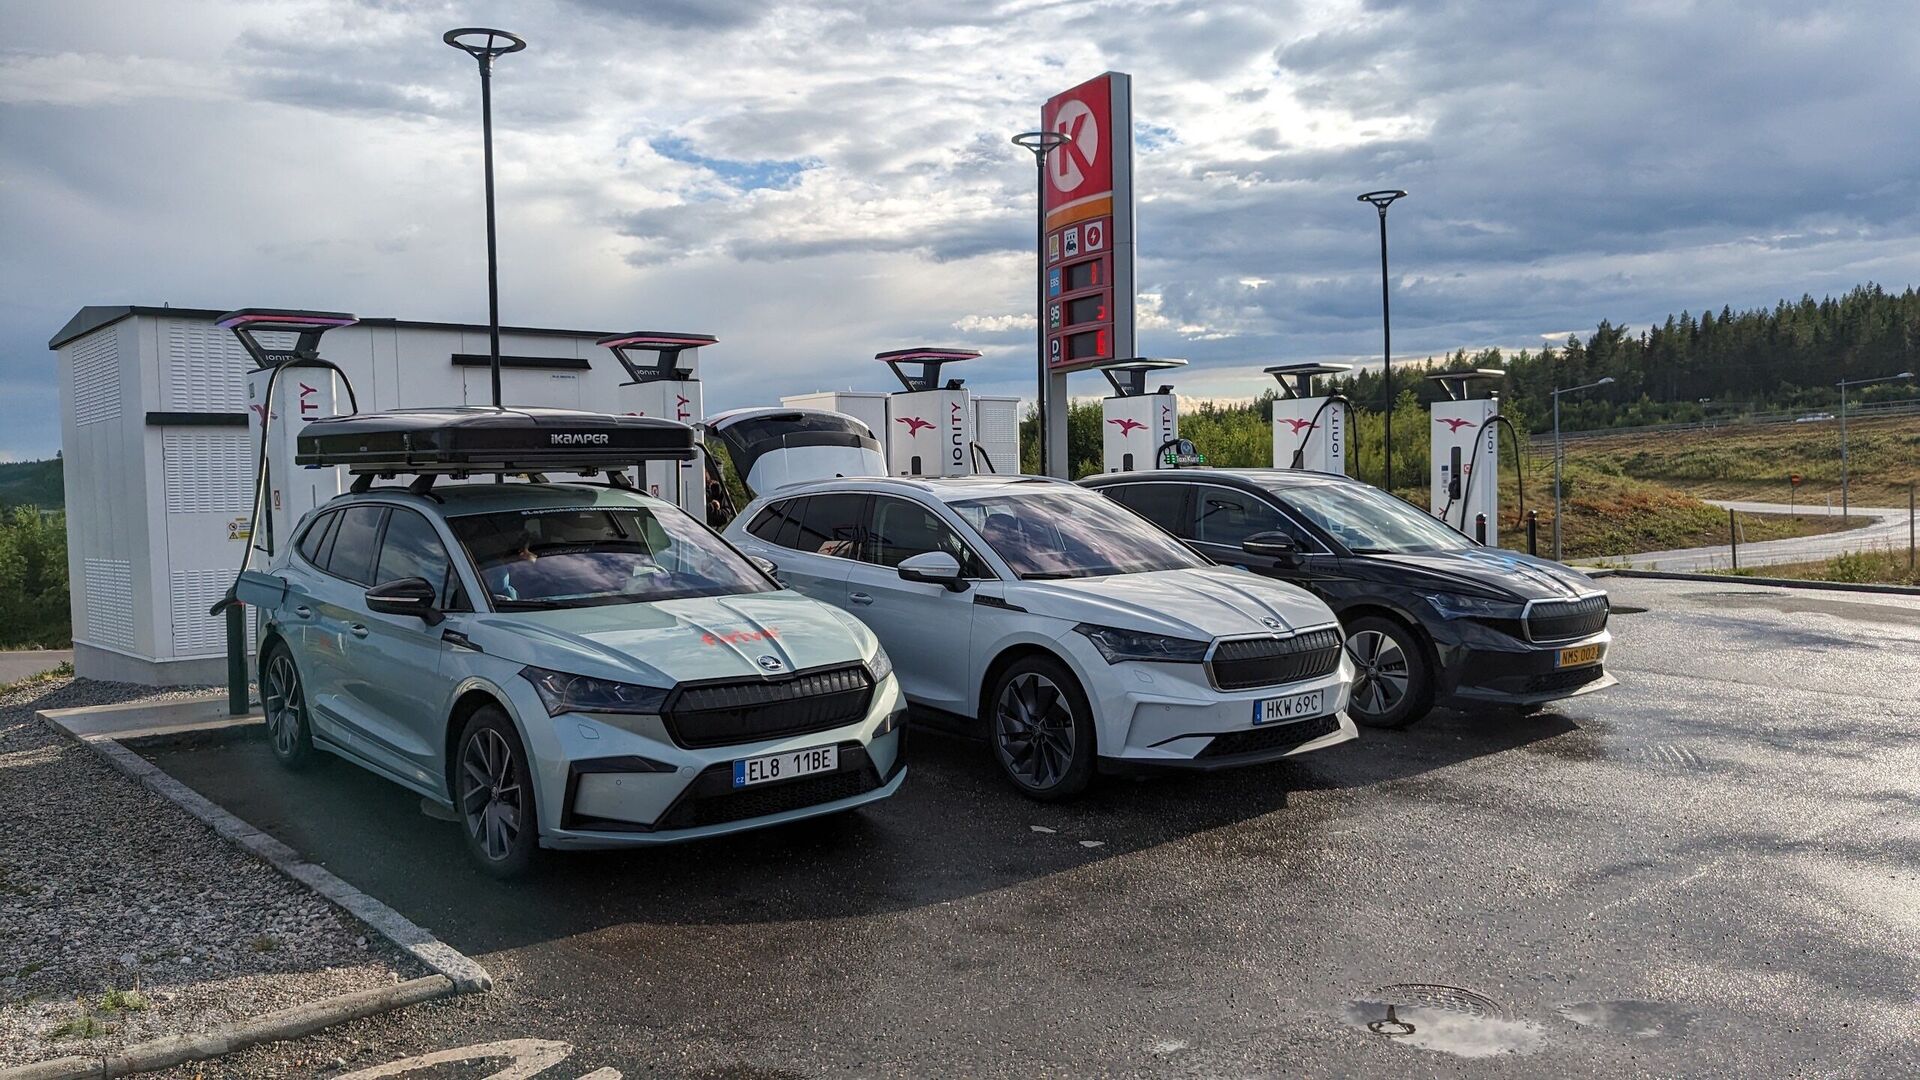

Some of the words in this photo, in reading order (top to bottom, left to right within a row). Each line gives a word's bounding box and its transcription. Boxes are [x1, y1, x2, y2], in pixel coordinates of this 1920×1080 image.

[1051, 305, 1060, 321] 95
[1052, 339, 1059, 354] D
[951, 401, 963, 466] IONITY
[1331, 406, 1339, 458] IONITY
[1562, 650, 1578, 665] NMS
[1267, 698, 1292, 719] HKW
[1295, 694, 1318, 714] 69C
[749, 758, 780, 782] EL8
[793, 749, 831, 774] 11BE
[736, 776, 745, 784] CZ
